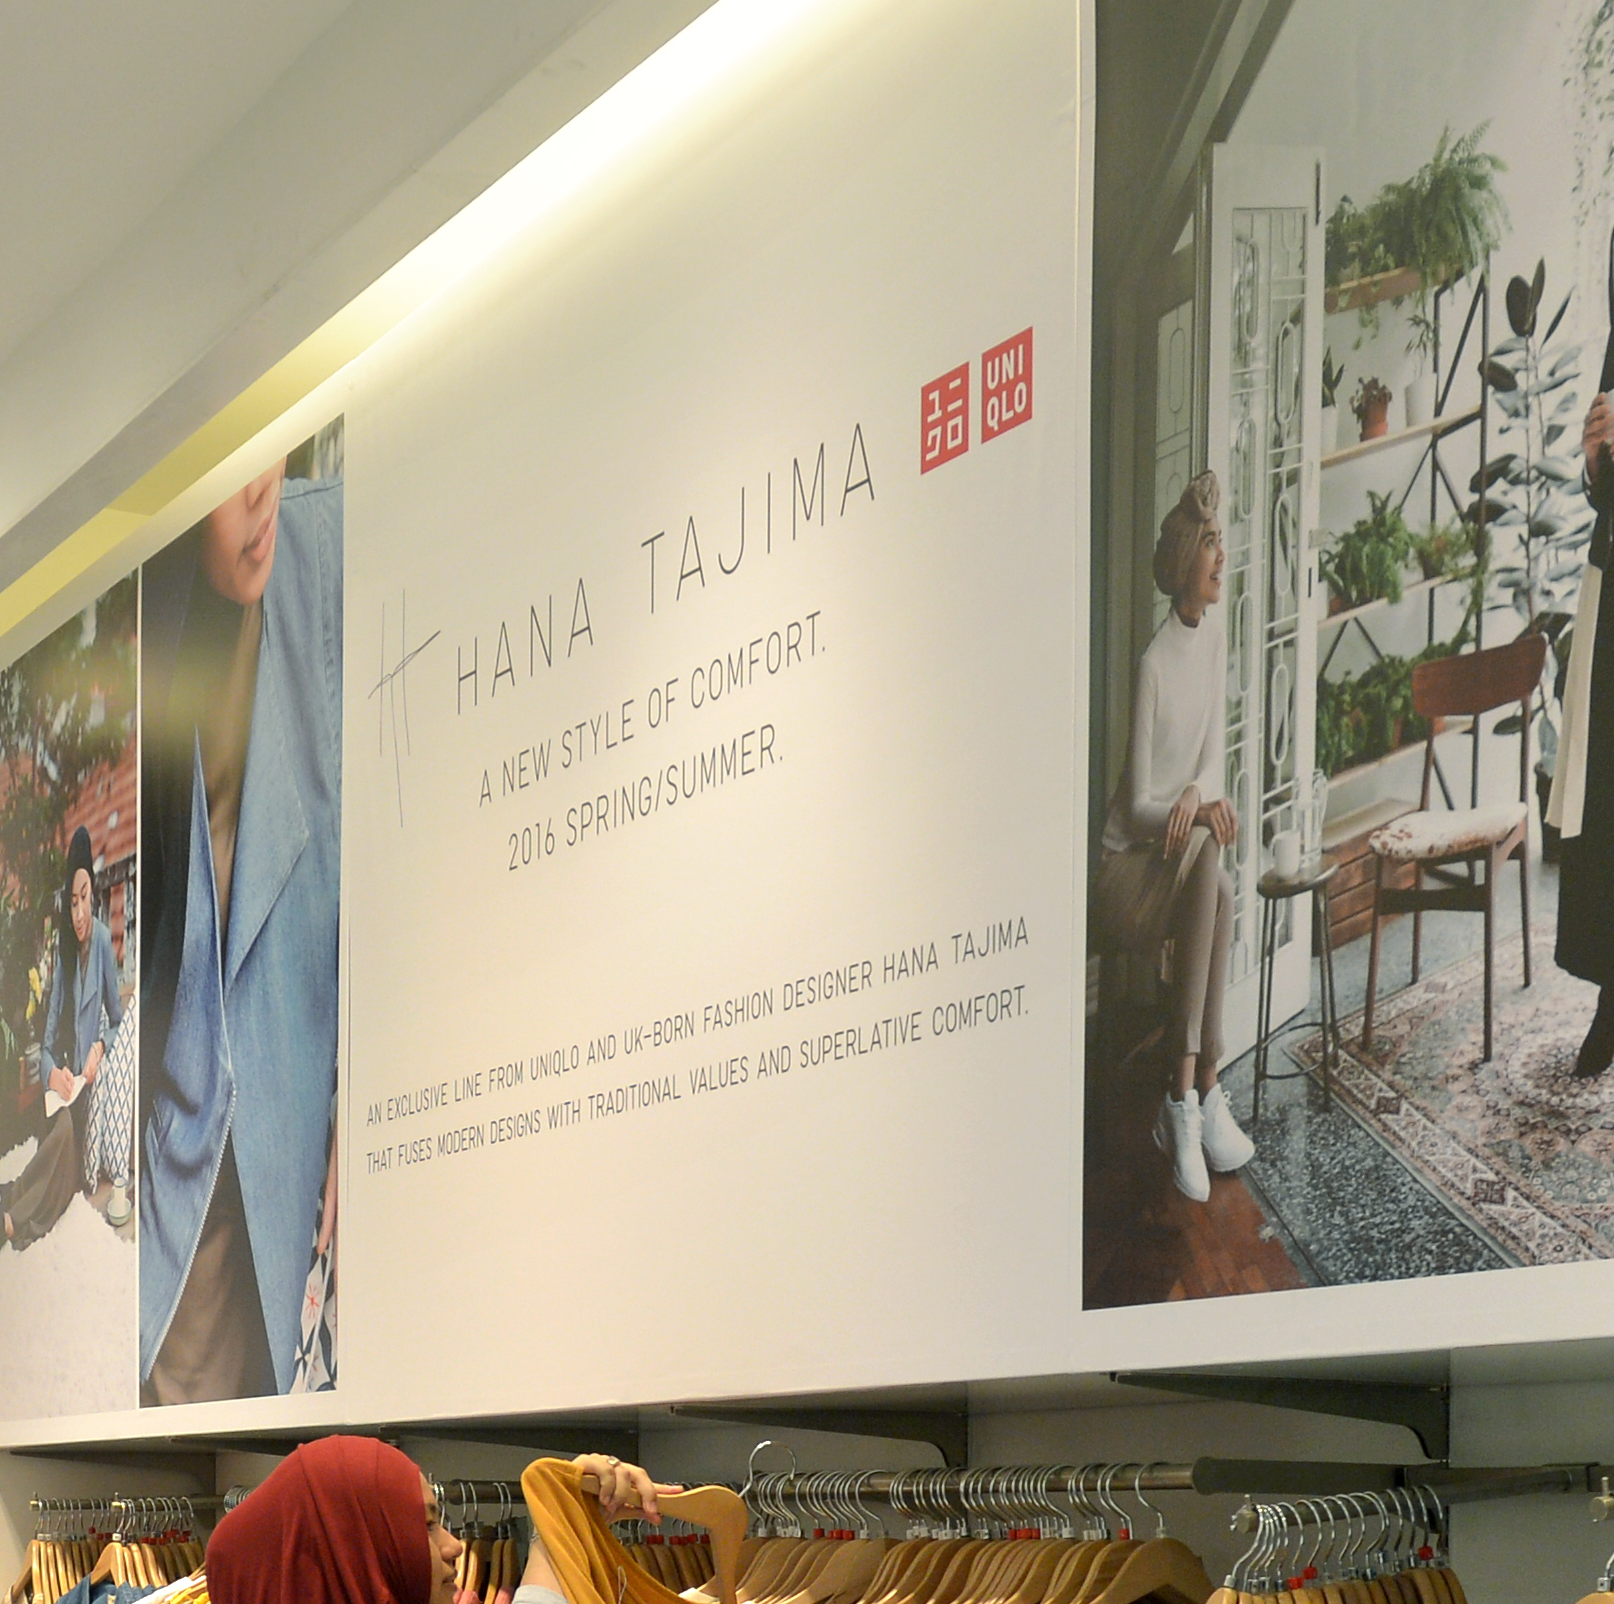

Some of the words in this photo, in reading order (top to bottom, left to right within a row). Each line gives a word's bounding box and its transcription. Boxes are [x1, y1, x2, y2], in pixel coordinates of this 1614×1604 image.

[987, 343, 1024, 390] UNI
[987, 381, 1027, 432] QLO
[457, 577, 594, 716] HANA
[640, 422, 876, 615] TAJIMA
[478, 768, 493, 808] A
[502, 738, 552, 797] NEW
[561, 698, 635, 770] STYLE
[647, 676, 680, 730] OF
[690, 609, 826, 710] COMFORT.
[508, 817, 556, 872] 2016
[565, 722, 784, 848] SPRING/SUMMER.
[366, 1101, 382, 1127] AN
[386, 1081, 449, 1122] EXCLUSIVE
[454, 1071, 483, 1103] LINE
[488, 1060, 524, 1093] FROM
[529, 1044, 580, 1082] UNIQLO
[586, 1033, 617, 1066] AND
[623, 1010, 695, 1056] UK-BORN
[703, 987, 774, 1034] FASHION
[782, 959, 873, 1012] DESIGNER
[882, 941, 940, 985] HANA
[950, 915, 1030, 965] TAJIMA
[366, 1146, 394, 1175] THAT
[397, 1136, 433, 1167] FUSES
[437, 1123, 485, 1158] MODERN
[489, 1108, 542, 1145] DESIGNS
[546, 1098, 582, 1131] WITH
[587, 1074, 683, 1121] TRADITIONAL
[688, 1055, 749, 1096] VALUES
[756, 1044, 792, 1080] AND
[799, 1010, 923, 1069] SUPERLATIVE
[931, 983, 1029, 1037] COMFORT.
